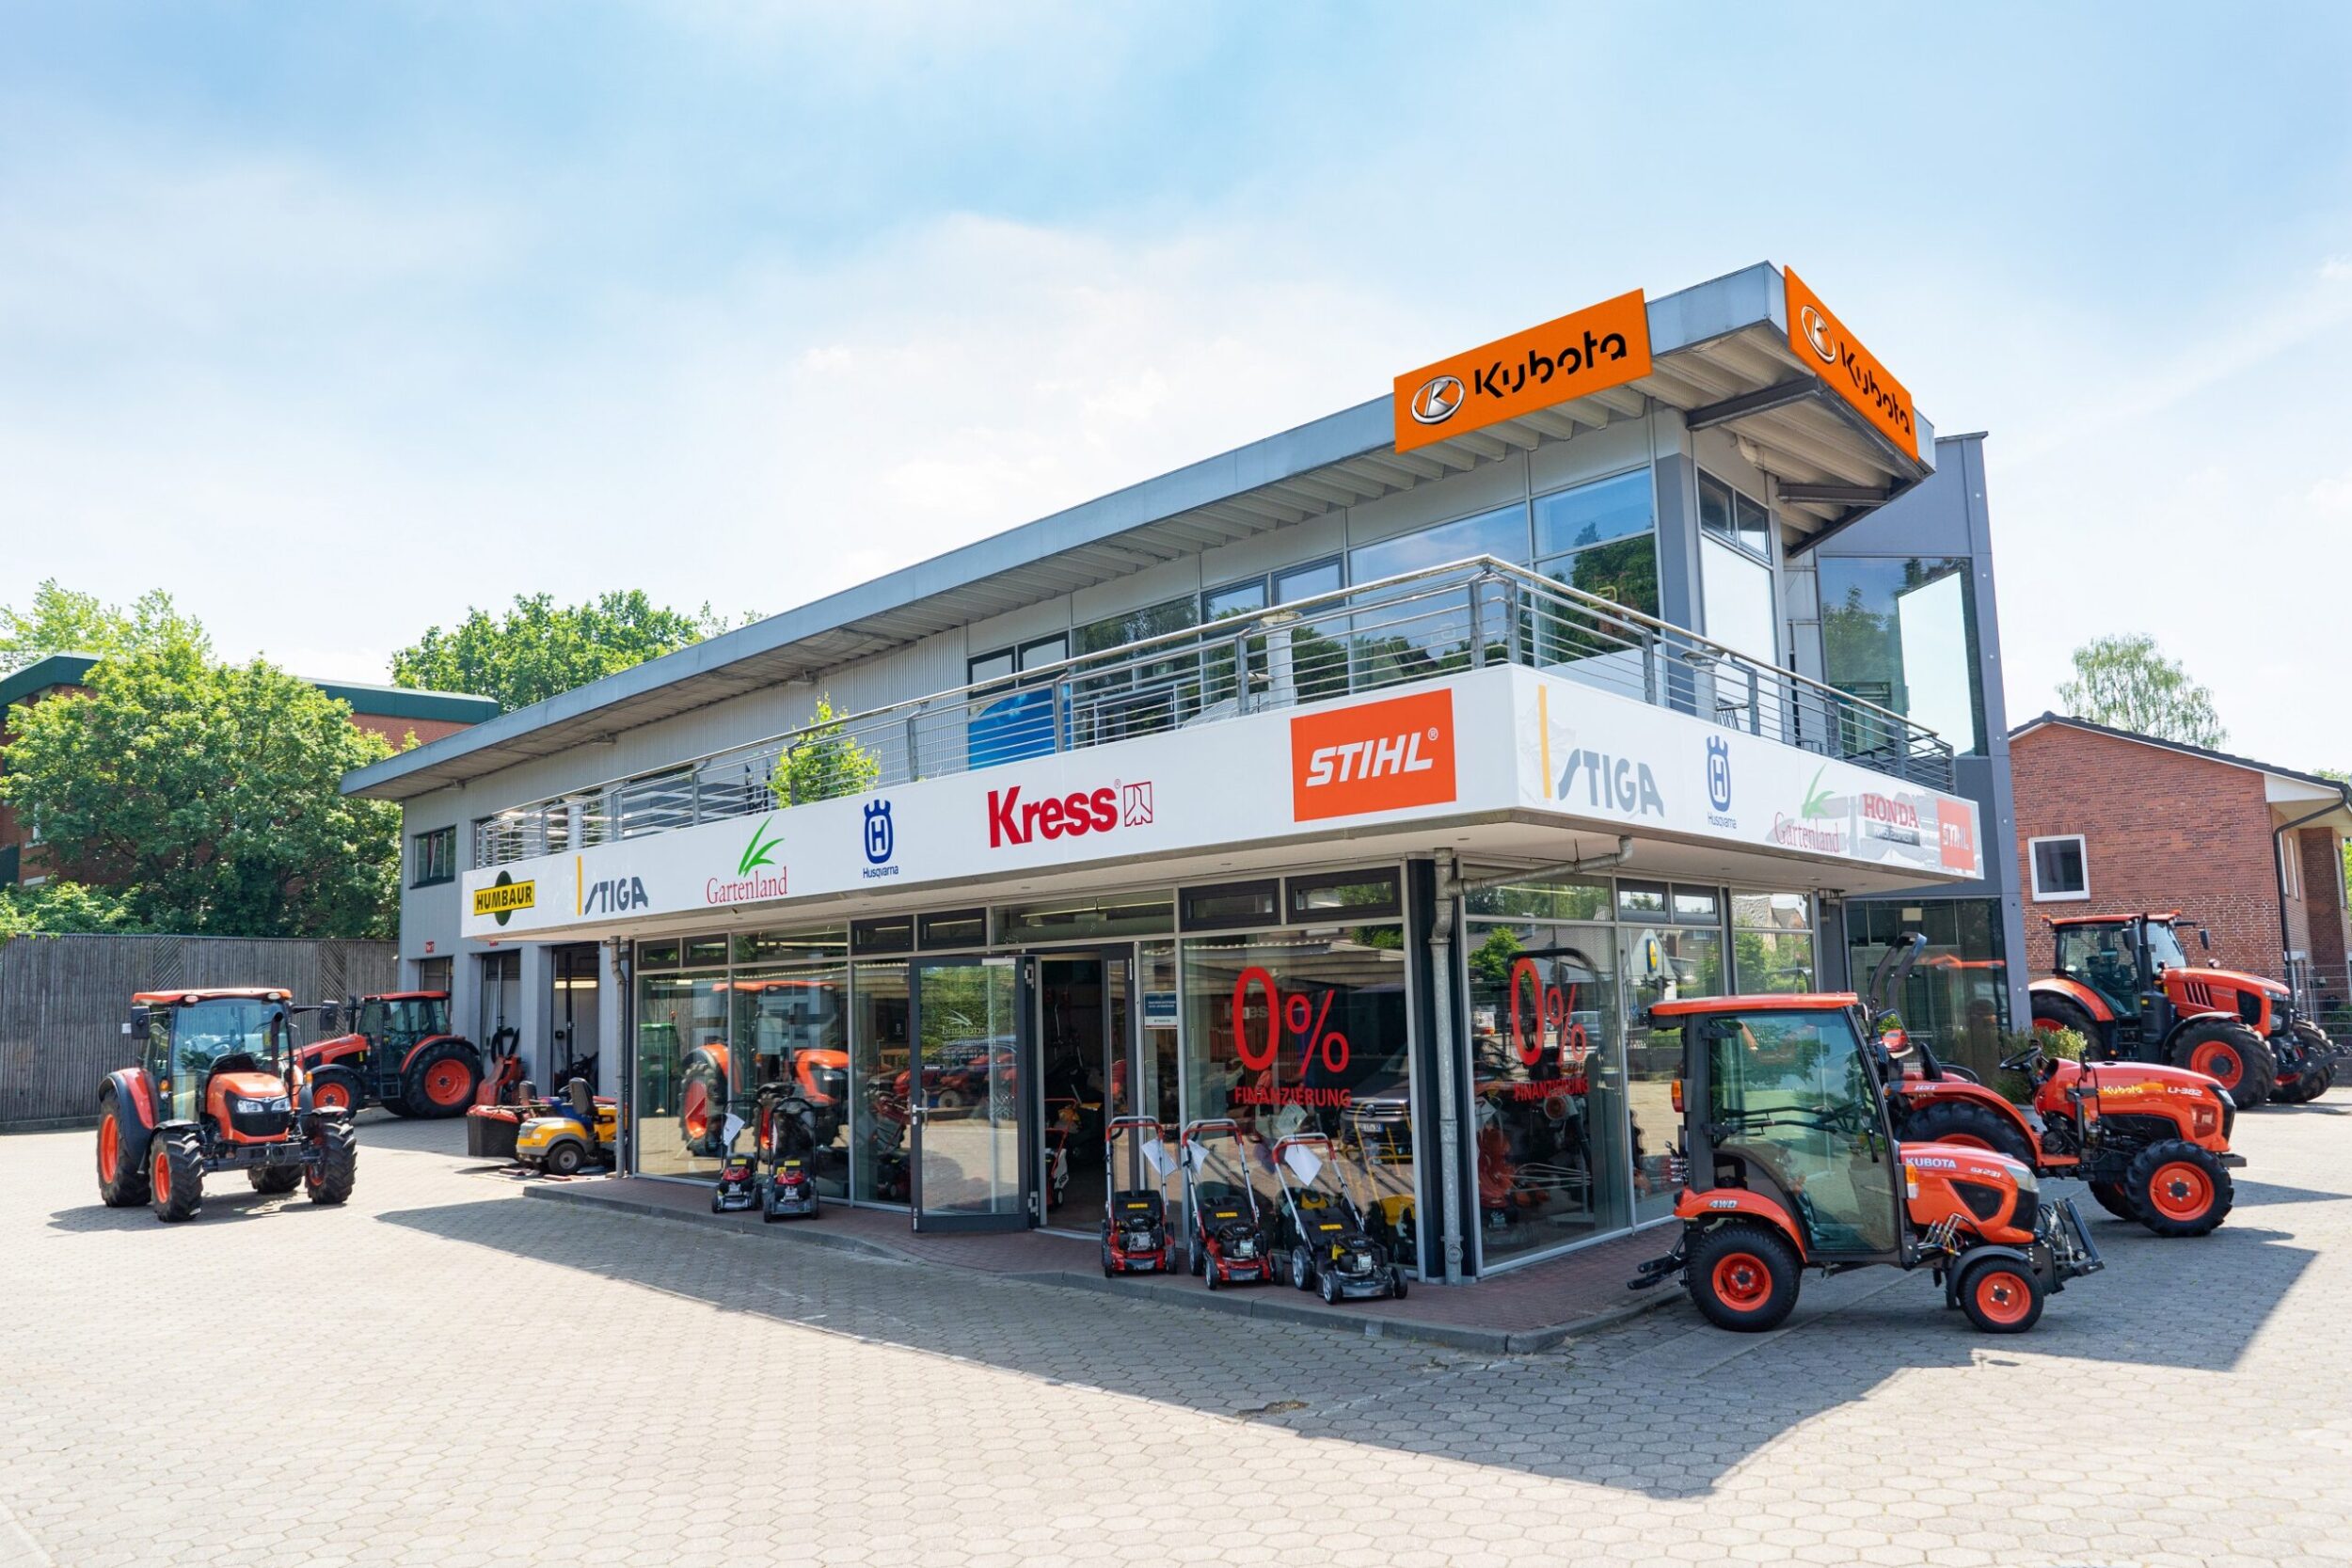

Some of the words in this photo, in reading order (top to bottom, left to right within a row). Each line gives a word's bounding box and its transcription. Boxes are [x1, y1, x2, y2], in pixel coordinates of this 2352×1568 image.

[1474, 330, 1628, 399] Kubota
[1840, 341, 1911, 436] Kubota
[1306, 733, 1434, 787] STIHL
[1558, 749, 1664, 818] STIGA
[988, 786, 1119, 848] Kress
[1863, 793, 1919, 829] HONDA
[1774, 811, 1840, 853] Gartenland
[707, 866, 788, 905] Gartenland
[863, 865, 899, 879] Husqvarna
[476, 885, 532, 911] HUMBAUR
[584, 876, 649, 916] STIGA
[1232, 966, 1350, 1075] 0%
[1510, 958, 1587, 1067] 0%
[1234, 1085, 1352, 1108] FINANZIERUNG
[2103, 1085, 2143, 1096] Kubota
[1905, 1157, 1957, 1169] KUBOTA
